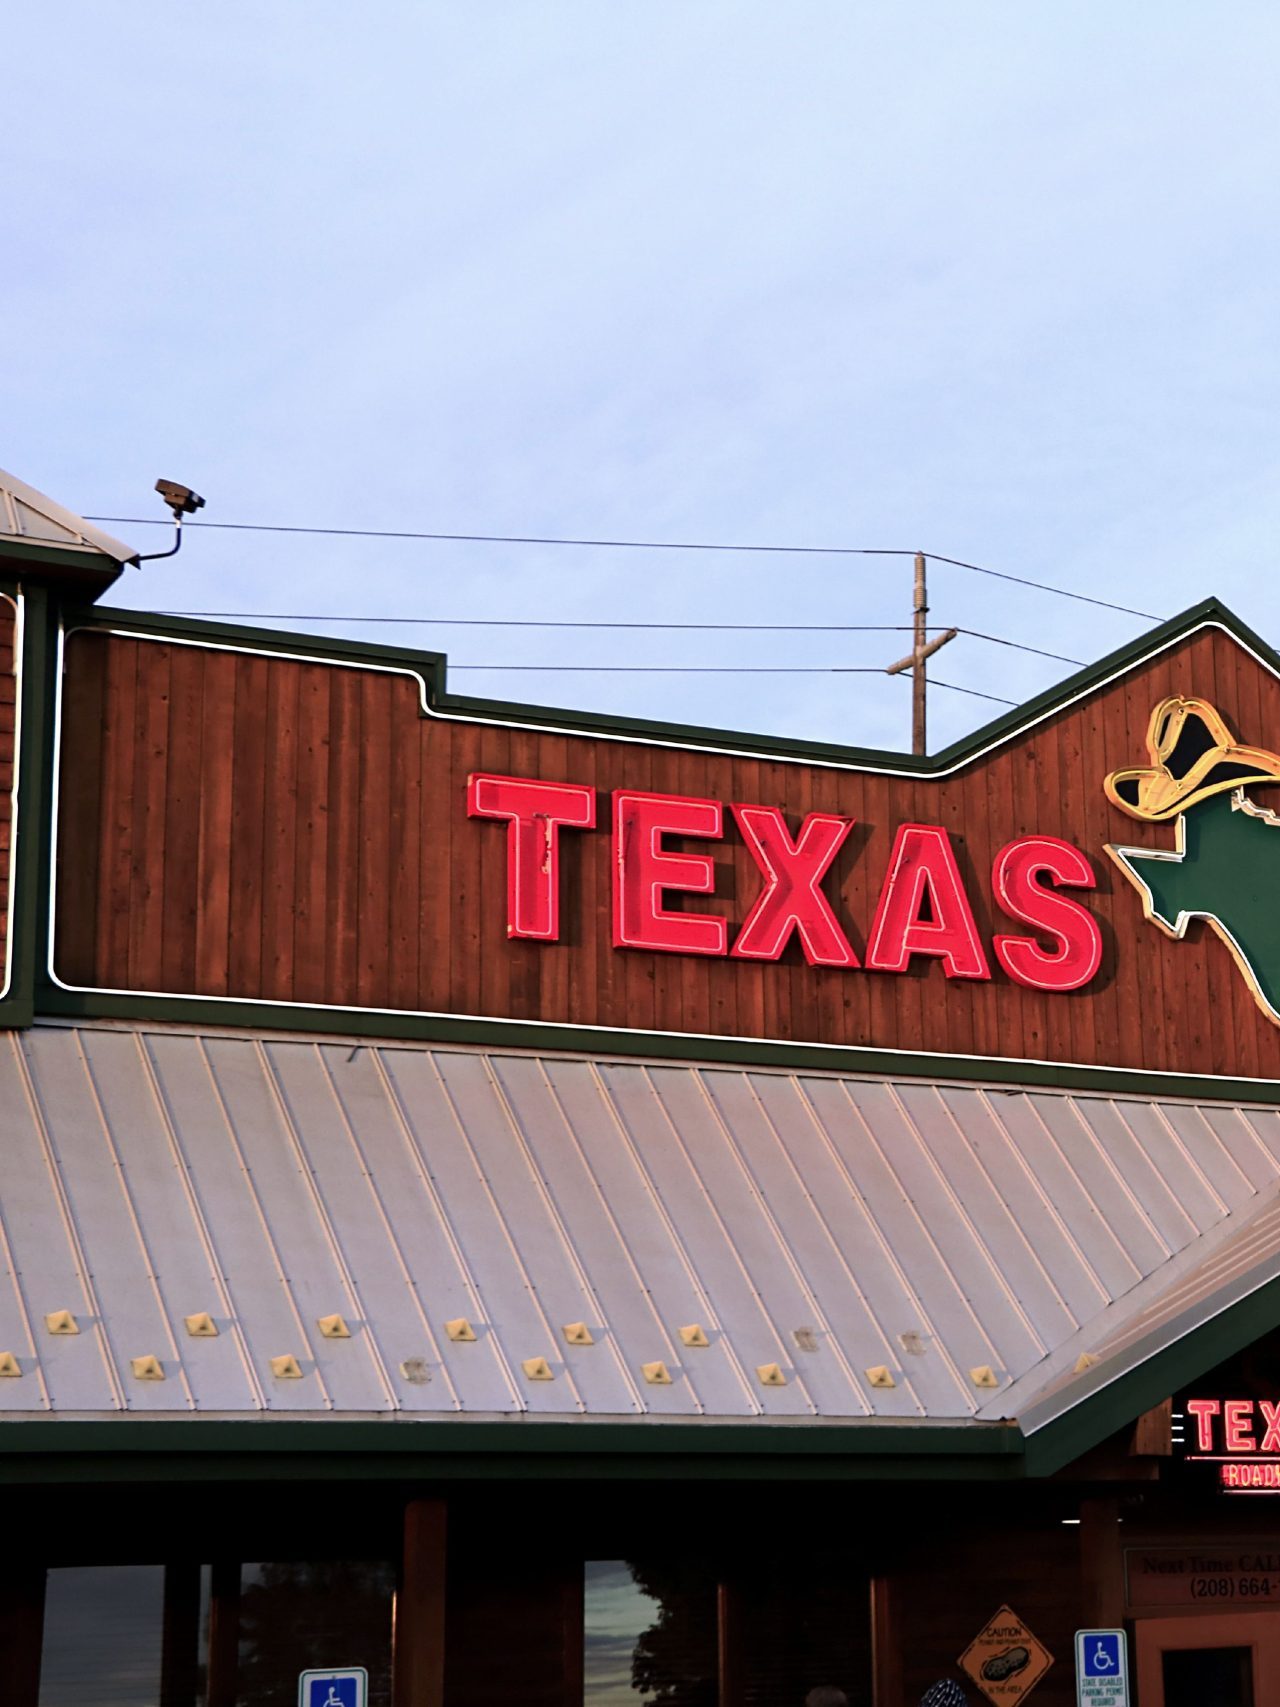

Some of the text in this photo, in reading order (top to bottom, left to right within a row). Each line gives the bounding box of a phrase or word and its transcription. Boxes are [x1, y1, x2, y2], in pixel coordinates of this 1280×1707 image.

[467, 773, 1103, 991] TEXAS
[1142, 1556, 1184, 1574] Next
[1187, 1556, 1233, 1573] Time
[1190, 1577, 1235, 1598] (208)
[987, 1627, 1022, 1637] CAUTION
